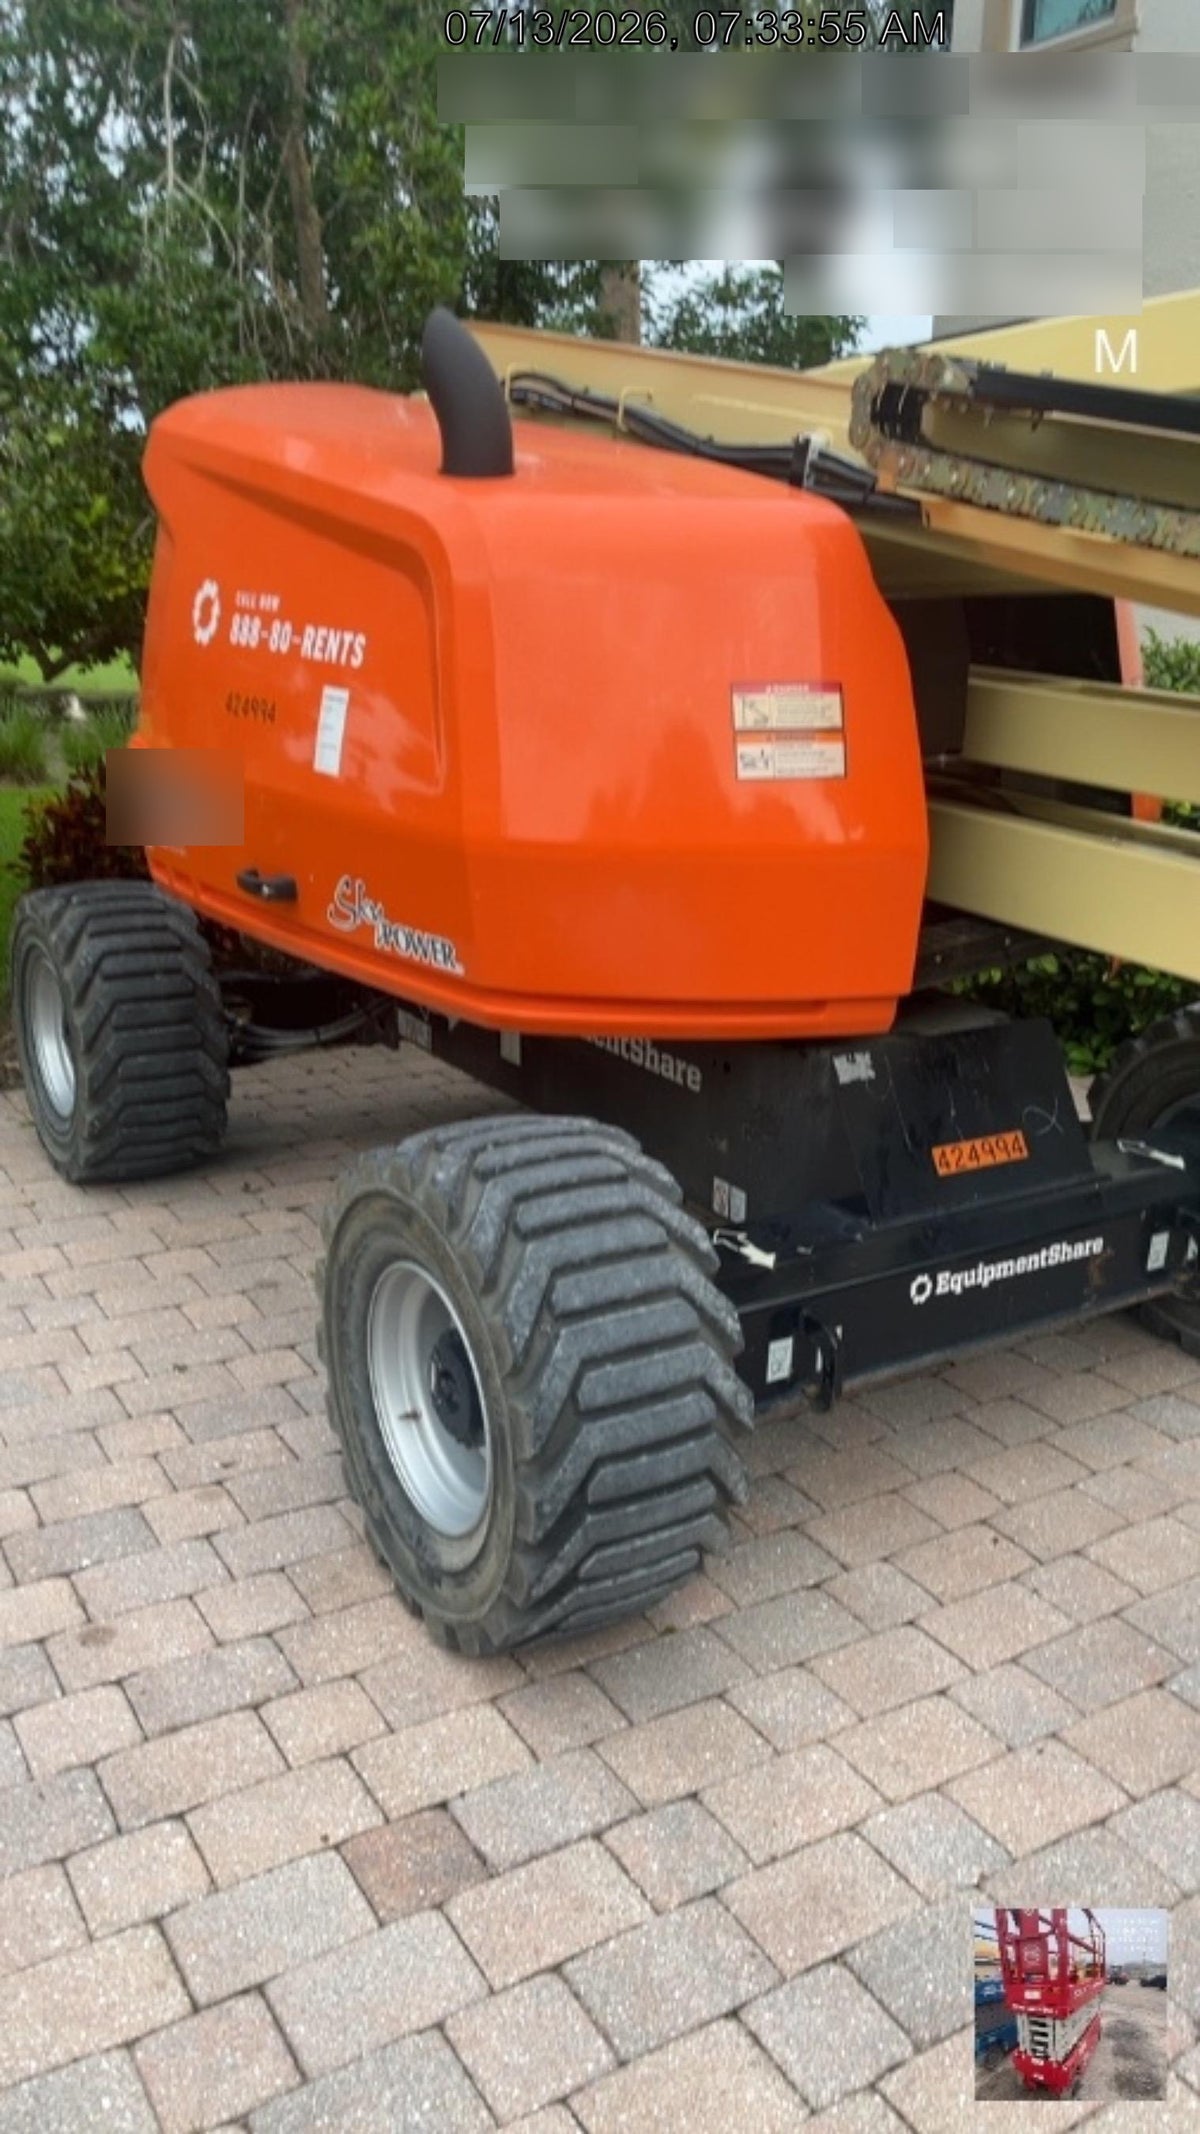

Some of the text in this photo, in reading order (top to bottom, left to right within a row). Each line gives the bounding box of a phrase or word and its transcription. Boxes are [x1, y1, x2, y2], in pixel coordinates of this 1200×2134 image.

[230, 612, 366, 669] 888-80-RENTS
[225, 690, 276, 724] 424994
[939, 1133, 1024, 1170] 424994
[935, 1237, 1104, 1296] EquipmentShare
